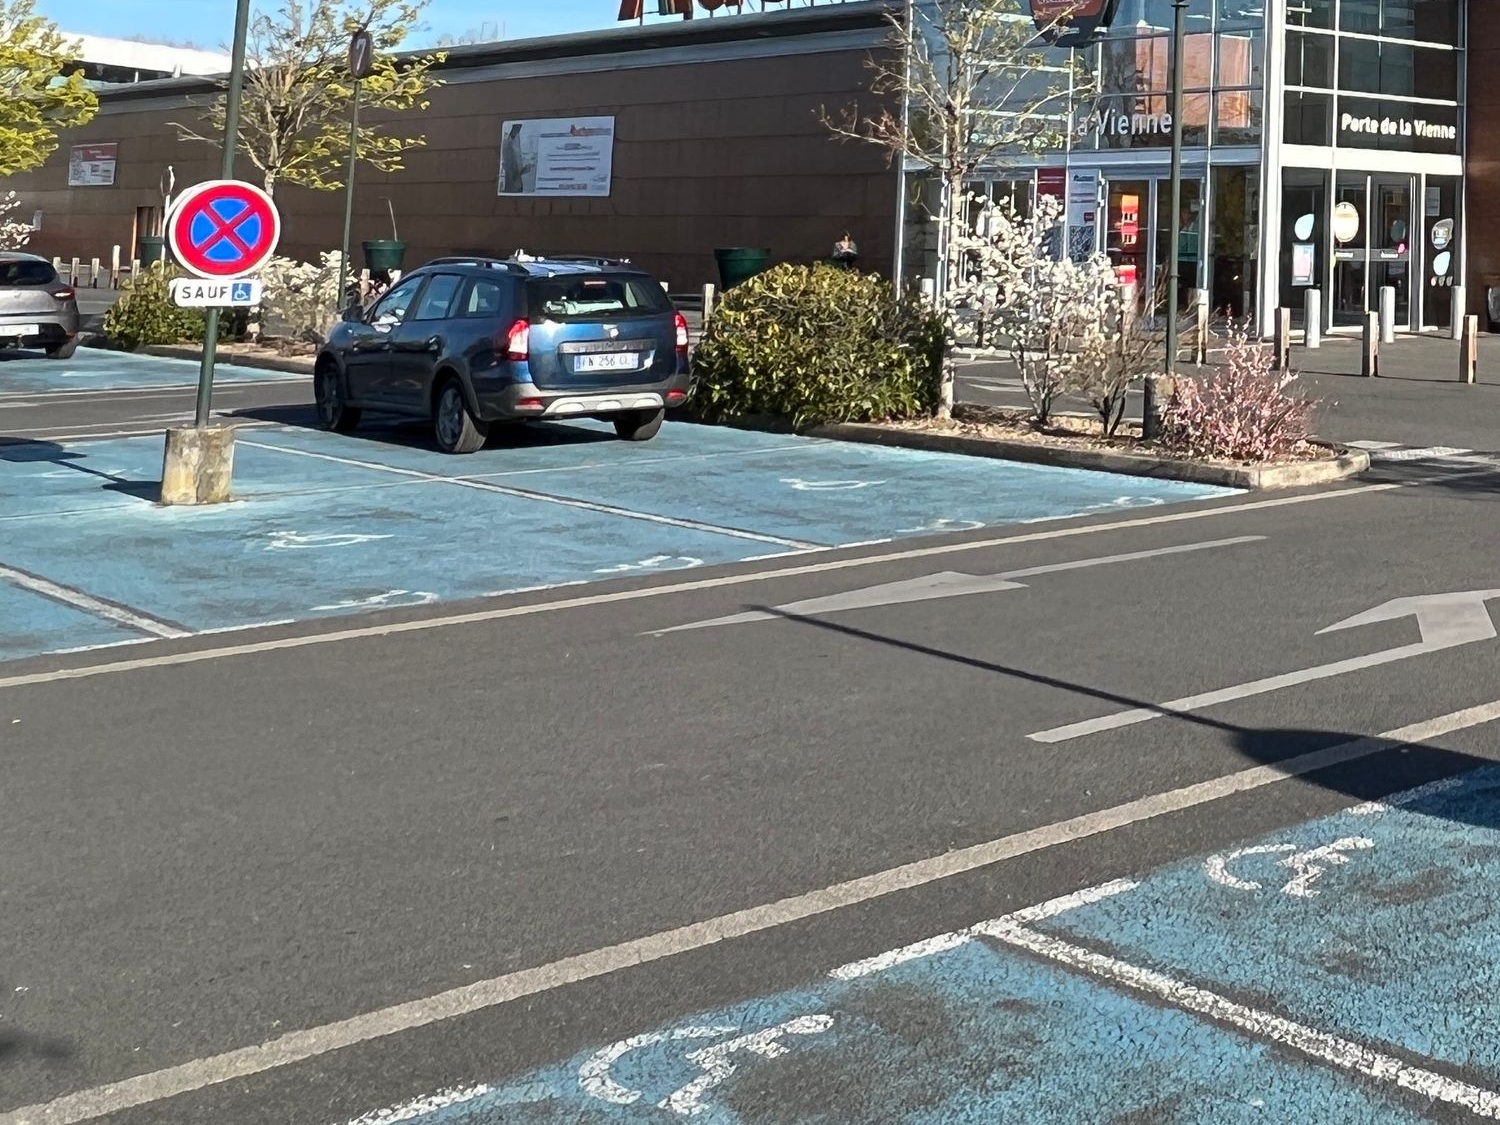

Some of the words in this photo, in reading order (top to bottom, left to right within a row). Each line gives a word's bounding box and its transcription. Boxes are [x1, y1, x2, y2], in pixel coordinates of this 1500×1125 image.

[356, 38, 367, 71] 7
[1097, 108, 1172, 136] Vienne
[1341, 113, 1379, 134] Porte
[1380, 117, 1398, 136] de
[1399, 118, 1412, 136] la
[1413, 120, 1456, 139] Vienne
[182, 286, 229, 299] SAUF
